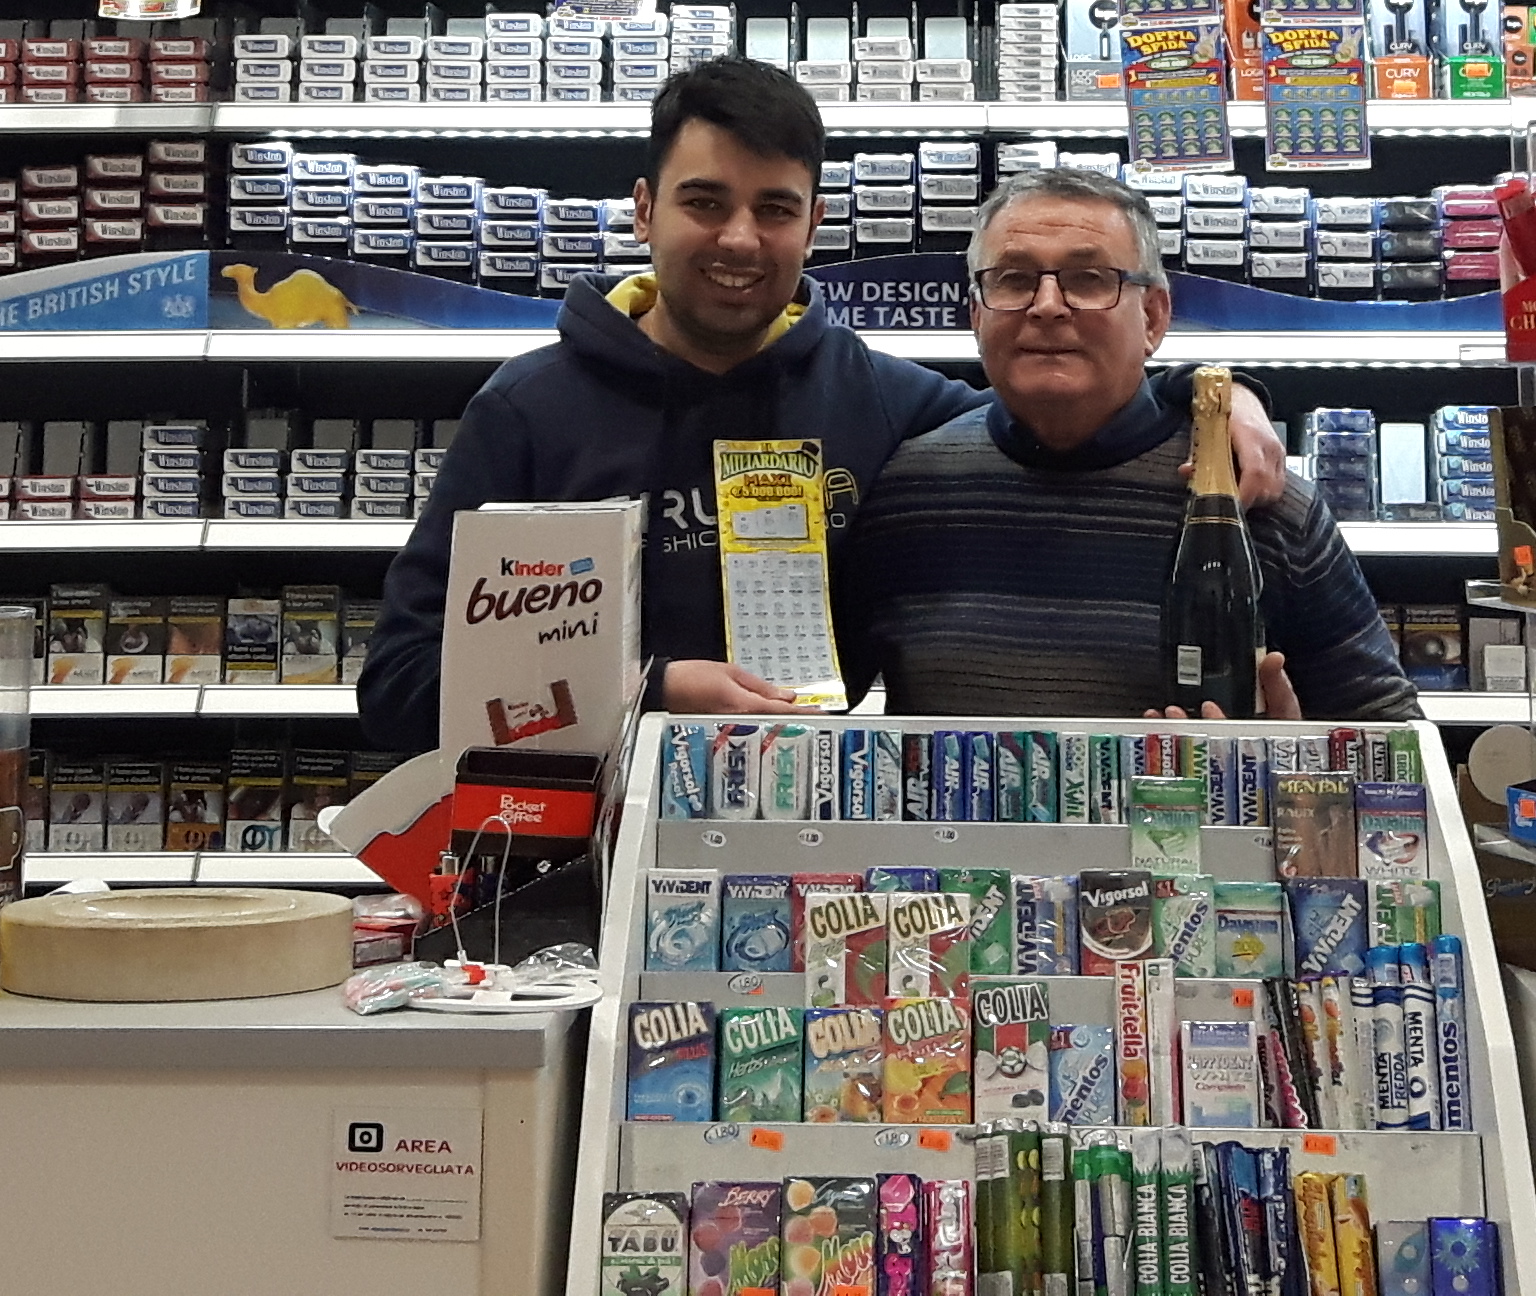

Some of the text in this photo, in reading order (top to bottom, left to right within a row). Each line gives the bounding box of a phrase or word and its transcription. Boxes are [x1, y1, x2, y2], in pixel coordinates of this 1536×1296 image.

[1384, 68, 1420, 79] CURV
[27, 274, 120, 317] BRITISH
[127, 259, 198, 296] STYLE
[863, 281, 969, 305] DESIGN,
[875, 307, 957, 326] TASTE
[720, 452, 814, 481] MILIARDARIO
[744, 474, 792, 487] MAXI
[465, 578, 604, 626] bueno
[537, 612, 600, 646] mini
[816, 731, 833, 804] Vigorsol
[499, 793, 547, 813] Pocket
[499, 810, 543, 825] Coffee
[1365, 865, 1420, 877] WHITE
[1082, 880, 1150, 908] Vigorsol
[1408, 1011, 1424, 1068] MENTA
[1375, 1051, 1408, 1109] MENTA FREDDA
[1446, 1021, 1463, 1129] mentos
[395, 1139, 452, 1153] AREA
[336, 1162, 475, 1175] VIDEOSORVEGLIATA
[720, 1186, 777, 1206] BERRY
[1139, 1182, 1159, 1238] BIANCA
[1170, 1182, 1190, 1238] BIANCA
[607, 1235, 677, 1253] TABU
